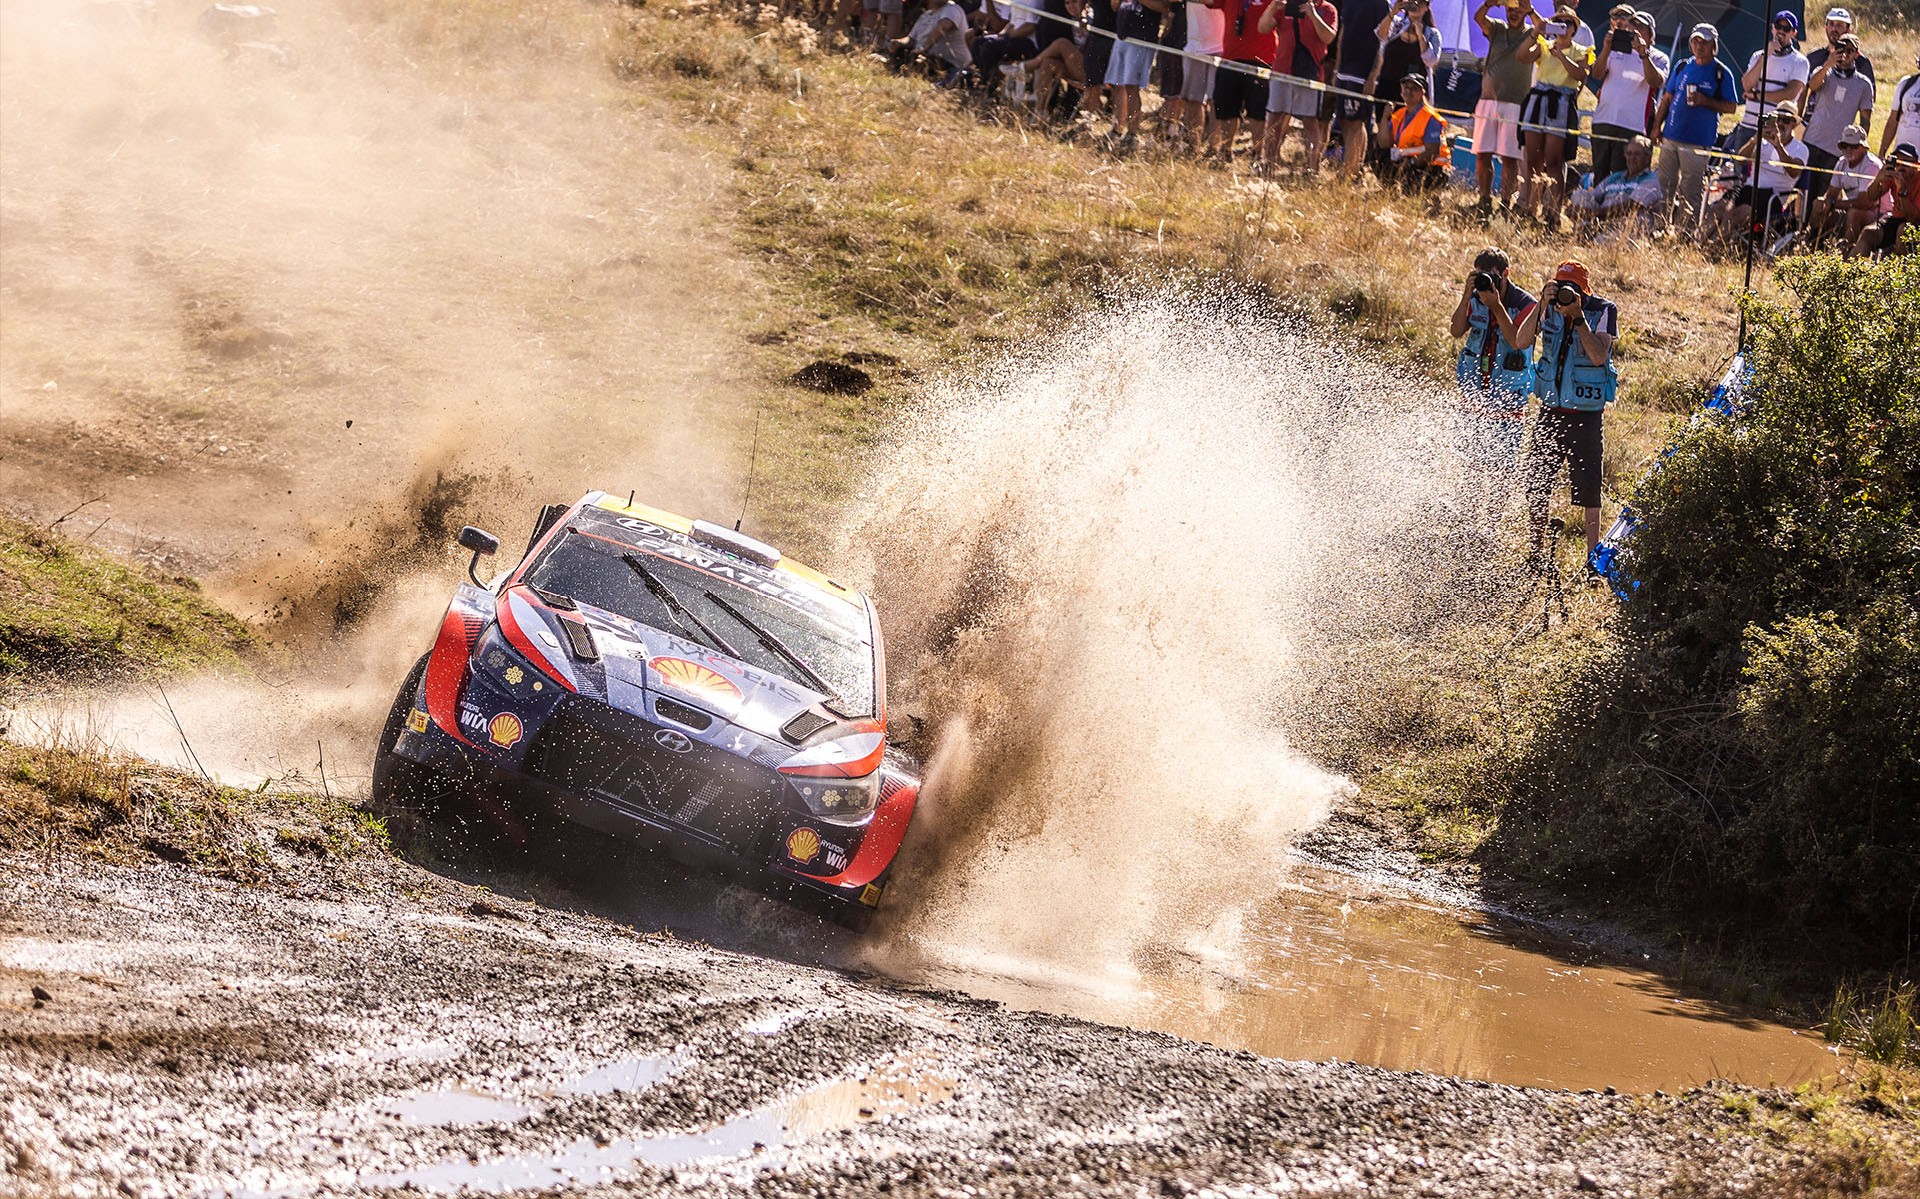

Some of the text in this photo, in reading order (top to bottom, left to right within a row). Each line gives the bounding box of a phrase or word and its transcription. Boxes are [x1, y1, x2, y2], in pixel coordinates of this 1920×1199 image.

[1575, 386, 1602, 400] 033
[636, 538, 806, 608] FANATEC
[668, 641, 801, 703] MOBIS
